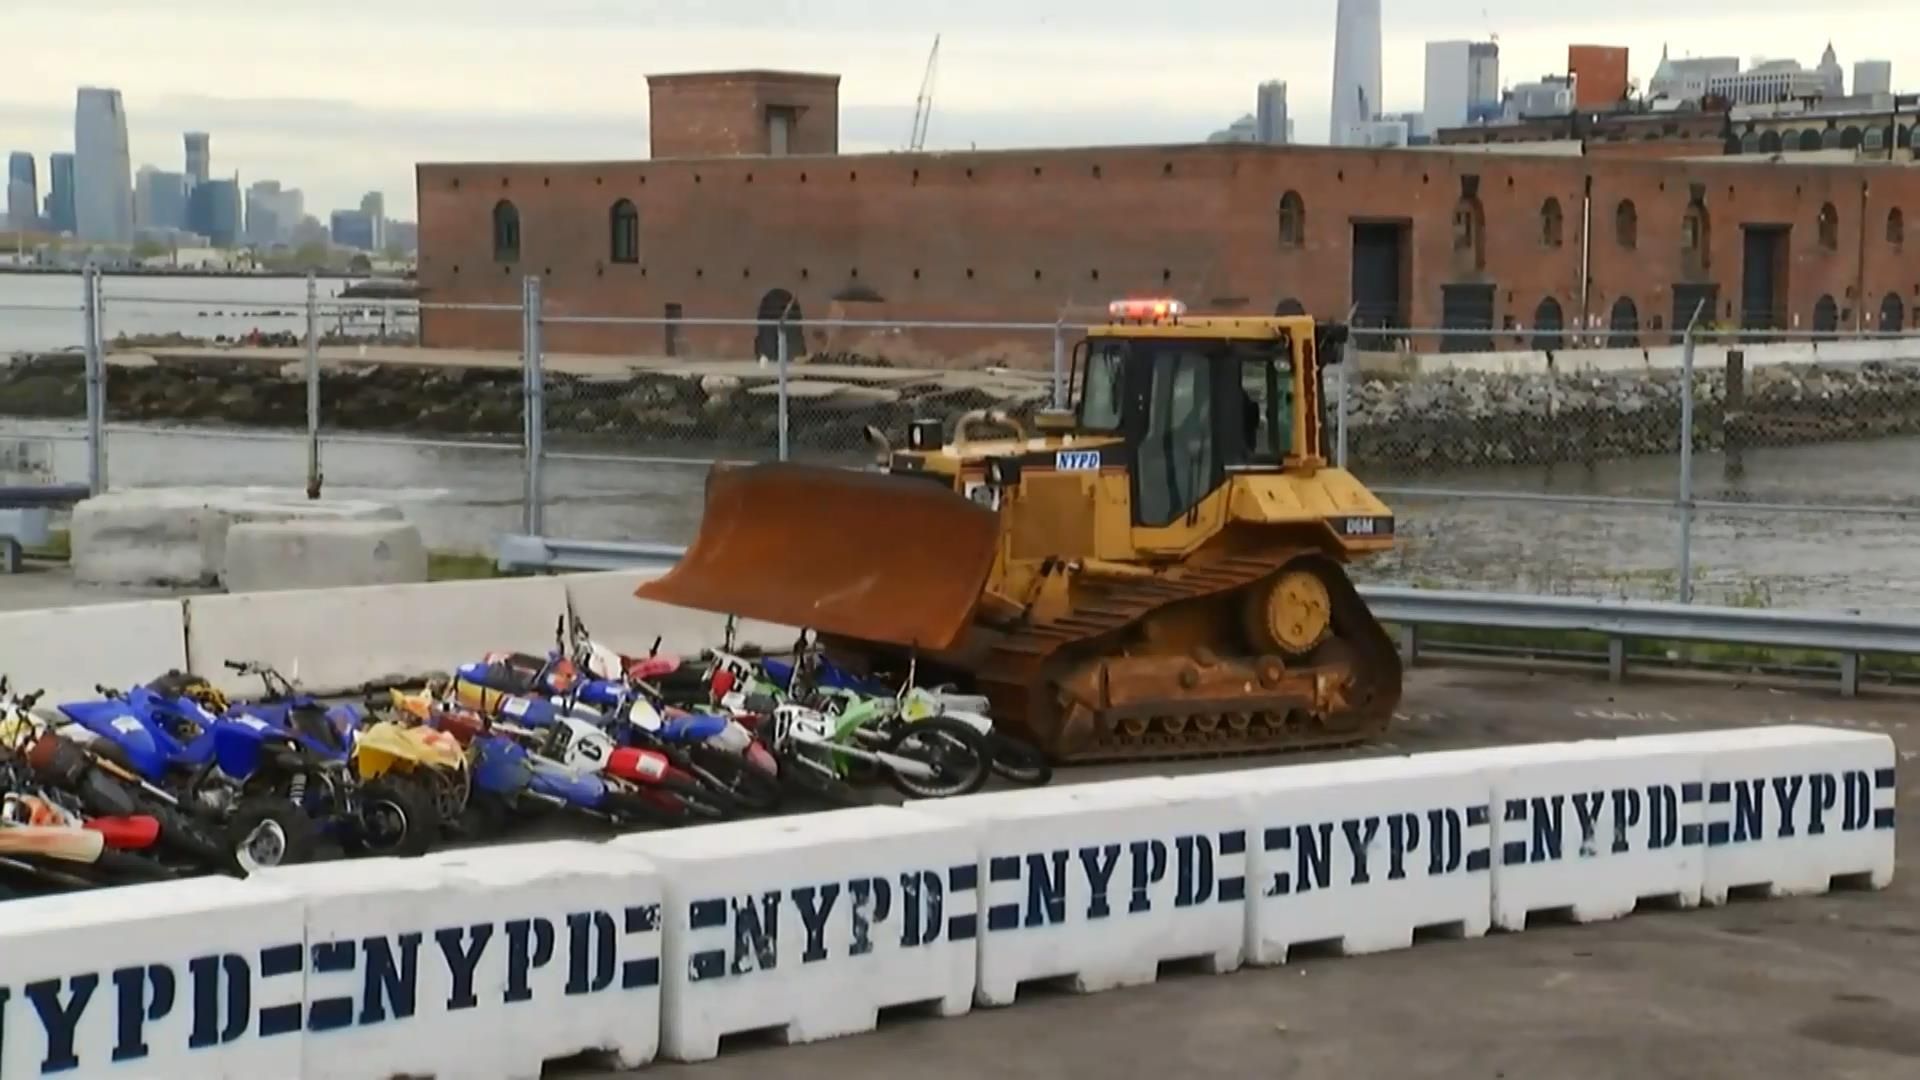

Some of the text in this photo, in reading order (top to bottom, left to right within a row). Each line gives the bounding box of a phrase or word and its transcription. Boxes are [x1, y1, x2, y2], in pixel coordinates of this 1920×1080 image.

[1058, 452, 1098, 469] NYPD
[1296, 805, 1461, 893] NYPD
[1530, 784, 1682, 864] NYPD
[1733, 770, 1873, 841] NYPD
[731, 870, 944, 975] NYPD
[1026, 834, 1214, 927] NYPD
[358, 910, 618, 1026] NYPD
[0, 952, 252, 1076] YPD
